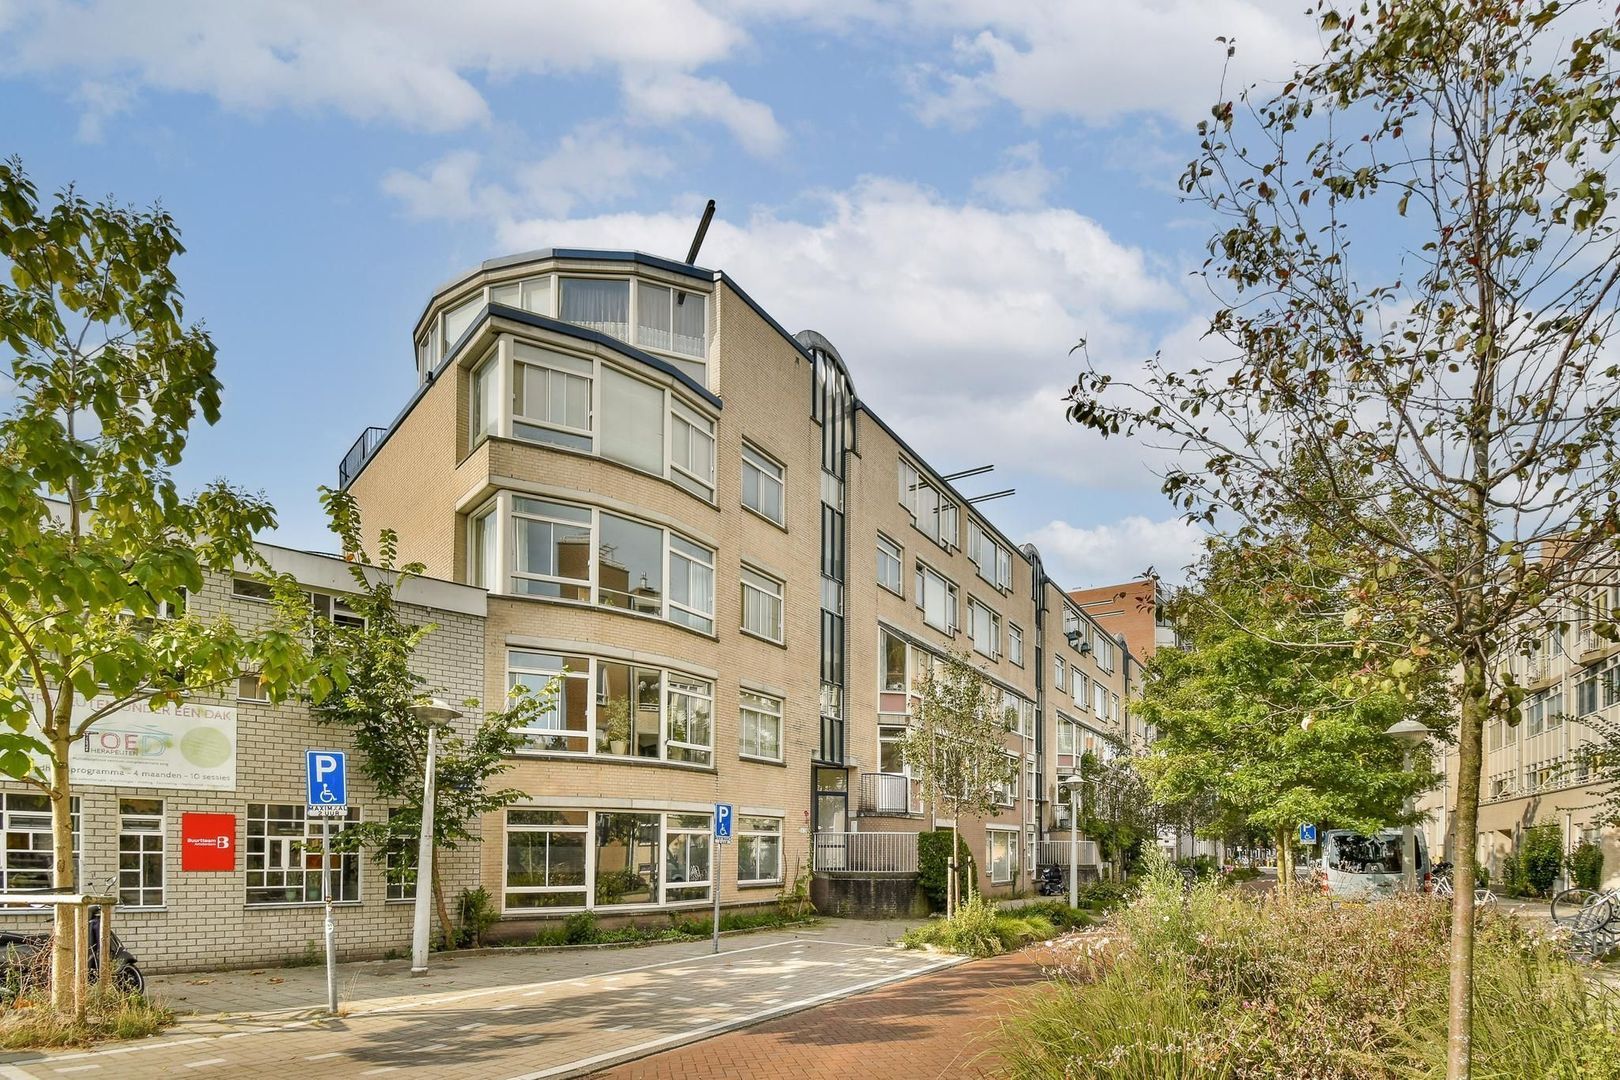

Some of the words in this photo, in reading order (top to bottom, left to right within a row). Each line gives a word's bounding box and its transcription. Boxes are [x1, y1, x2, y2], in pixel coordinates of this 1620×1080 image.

[121, 701, 170, 715] ONDR
[205, 709, 231, 721] DAK
[141, 770, 182, 779] maanden
[315, 755, 337, 782] P
[719, 806, 728, 822] P
[217, 835, 229, 848] B
